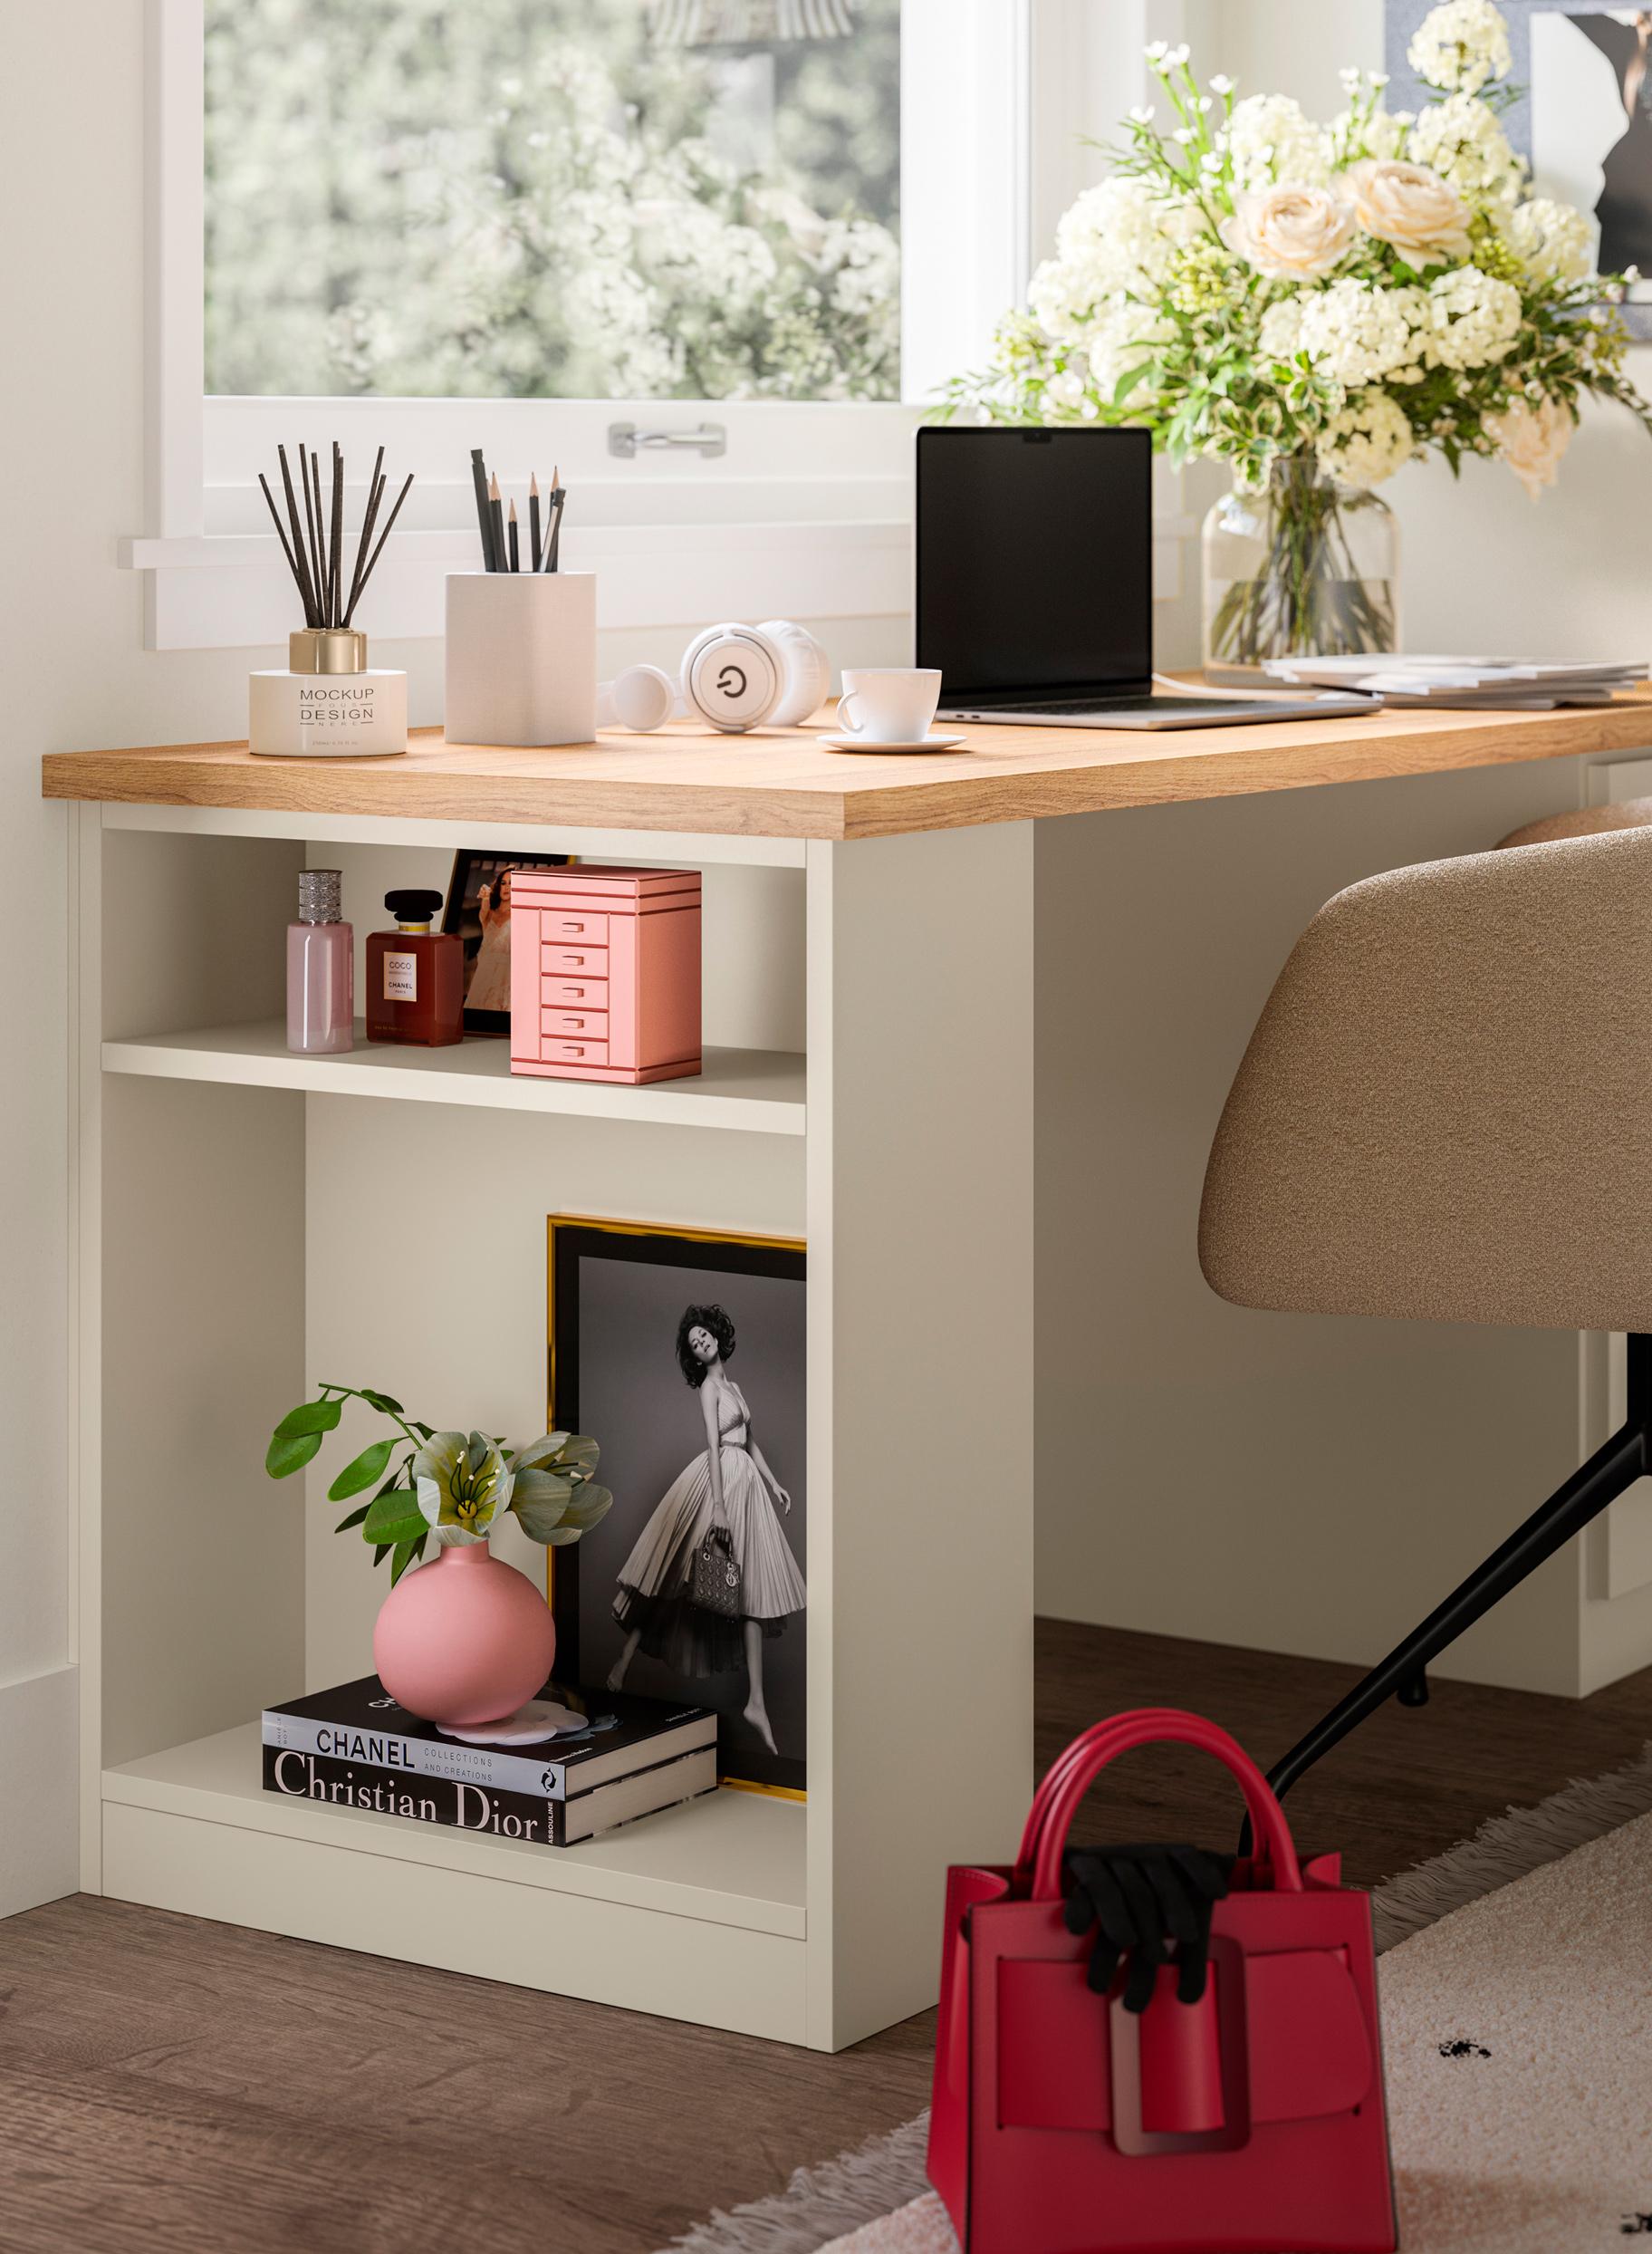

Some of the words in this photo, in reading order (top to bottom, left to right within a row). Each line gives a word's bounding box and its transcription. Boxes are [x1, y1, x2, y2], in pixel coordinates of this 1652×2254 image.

[300, 689, 374, 700] MOCKUP
[301, 708, 373, 720] DESIGN
[389, 961, 412, 970] COCO
[389, 981, 413, 989] CHANEL
[317, 1729, 416, 1768] CHANEL
[424, 1748, 493, 1768] COLLECTIONS
[424, 1763, 441, 1772] AND
[444, 1767, 493, 1782] CREATIONS
[274, 1750, 438, 1822] Christian
[450, 1782, 538, 1841] Dior
